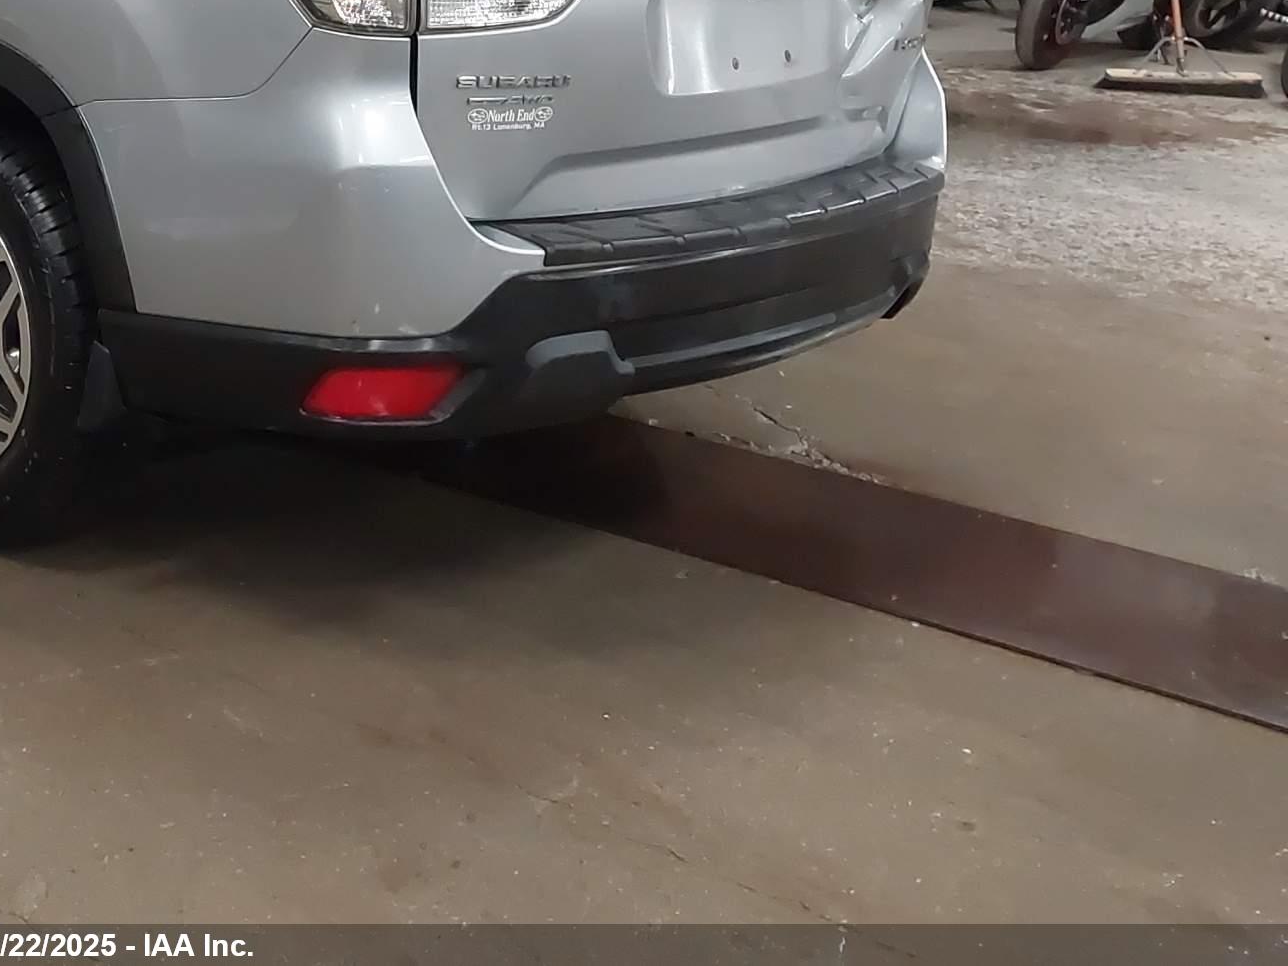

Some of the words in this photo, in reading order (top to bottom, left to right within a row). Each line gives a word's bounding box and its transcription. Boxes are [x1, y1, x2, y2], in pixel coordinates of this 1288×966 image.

[455, 74, 571, 89] SUBARU
[487, 108, 515, 122] North
[517, 108, 535, 122] End
